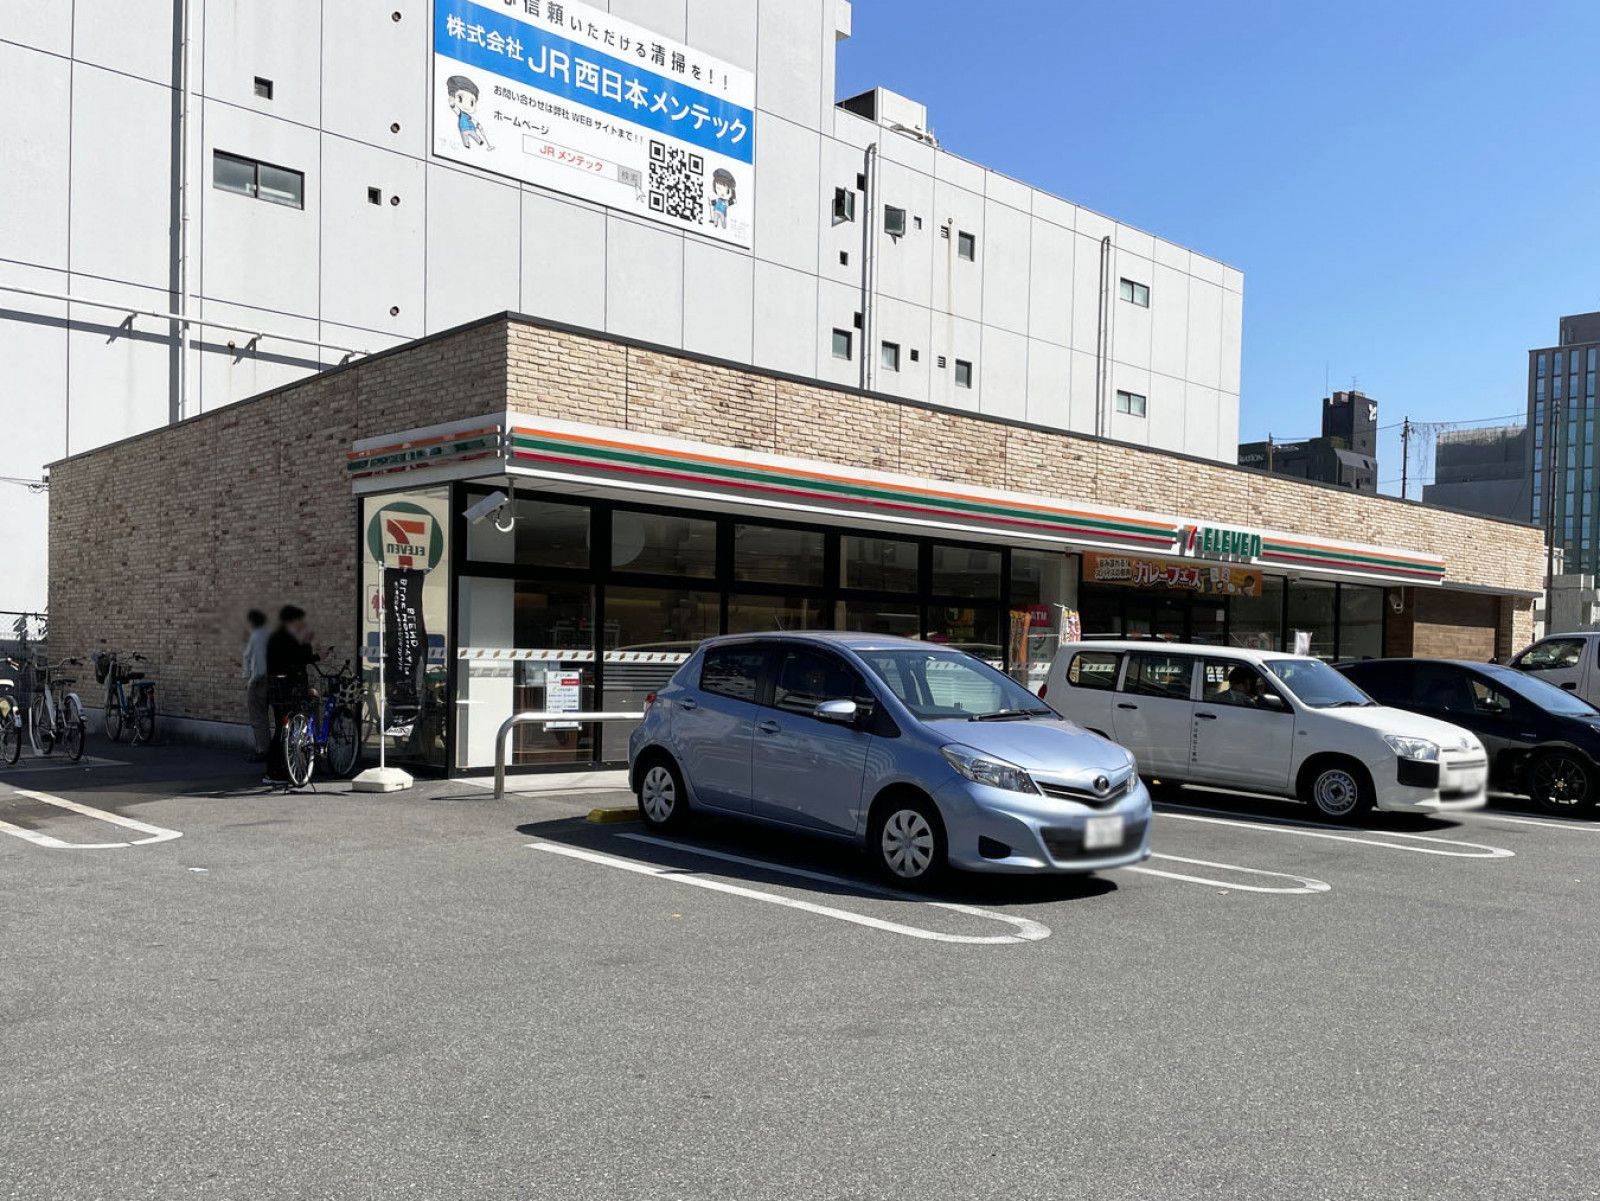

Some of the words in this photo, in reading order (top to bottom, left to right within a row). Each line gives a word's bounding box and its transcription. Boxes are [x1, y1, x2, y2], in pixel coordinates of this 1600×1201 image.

[504, 0, 728, 90] 信頼いただける清掃を!!
[493, 110, 550, 136] ホームページ
[1134, 560, 1202, 587] カレーフェス
